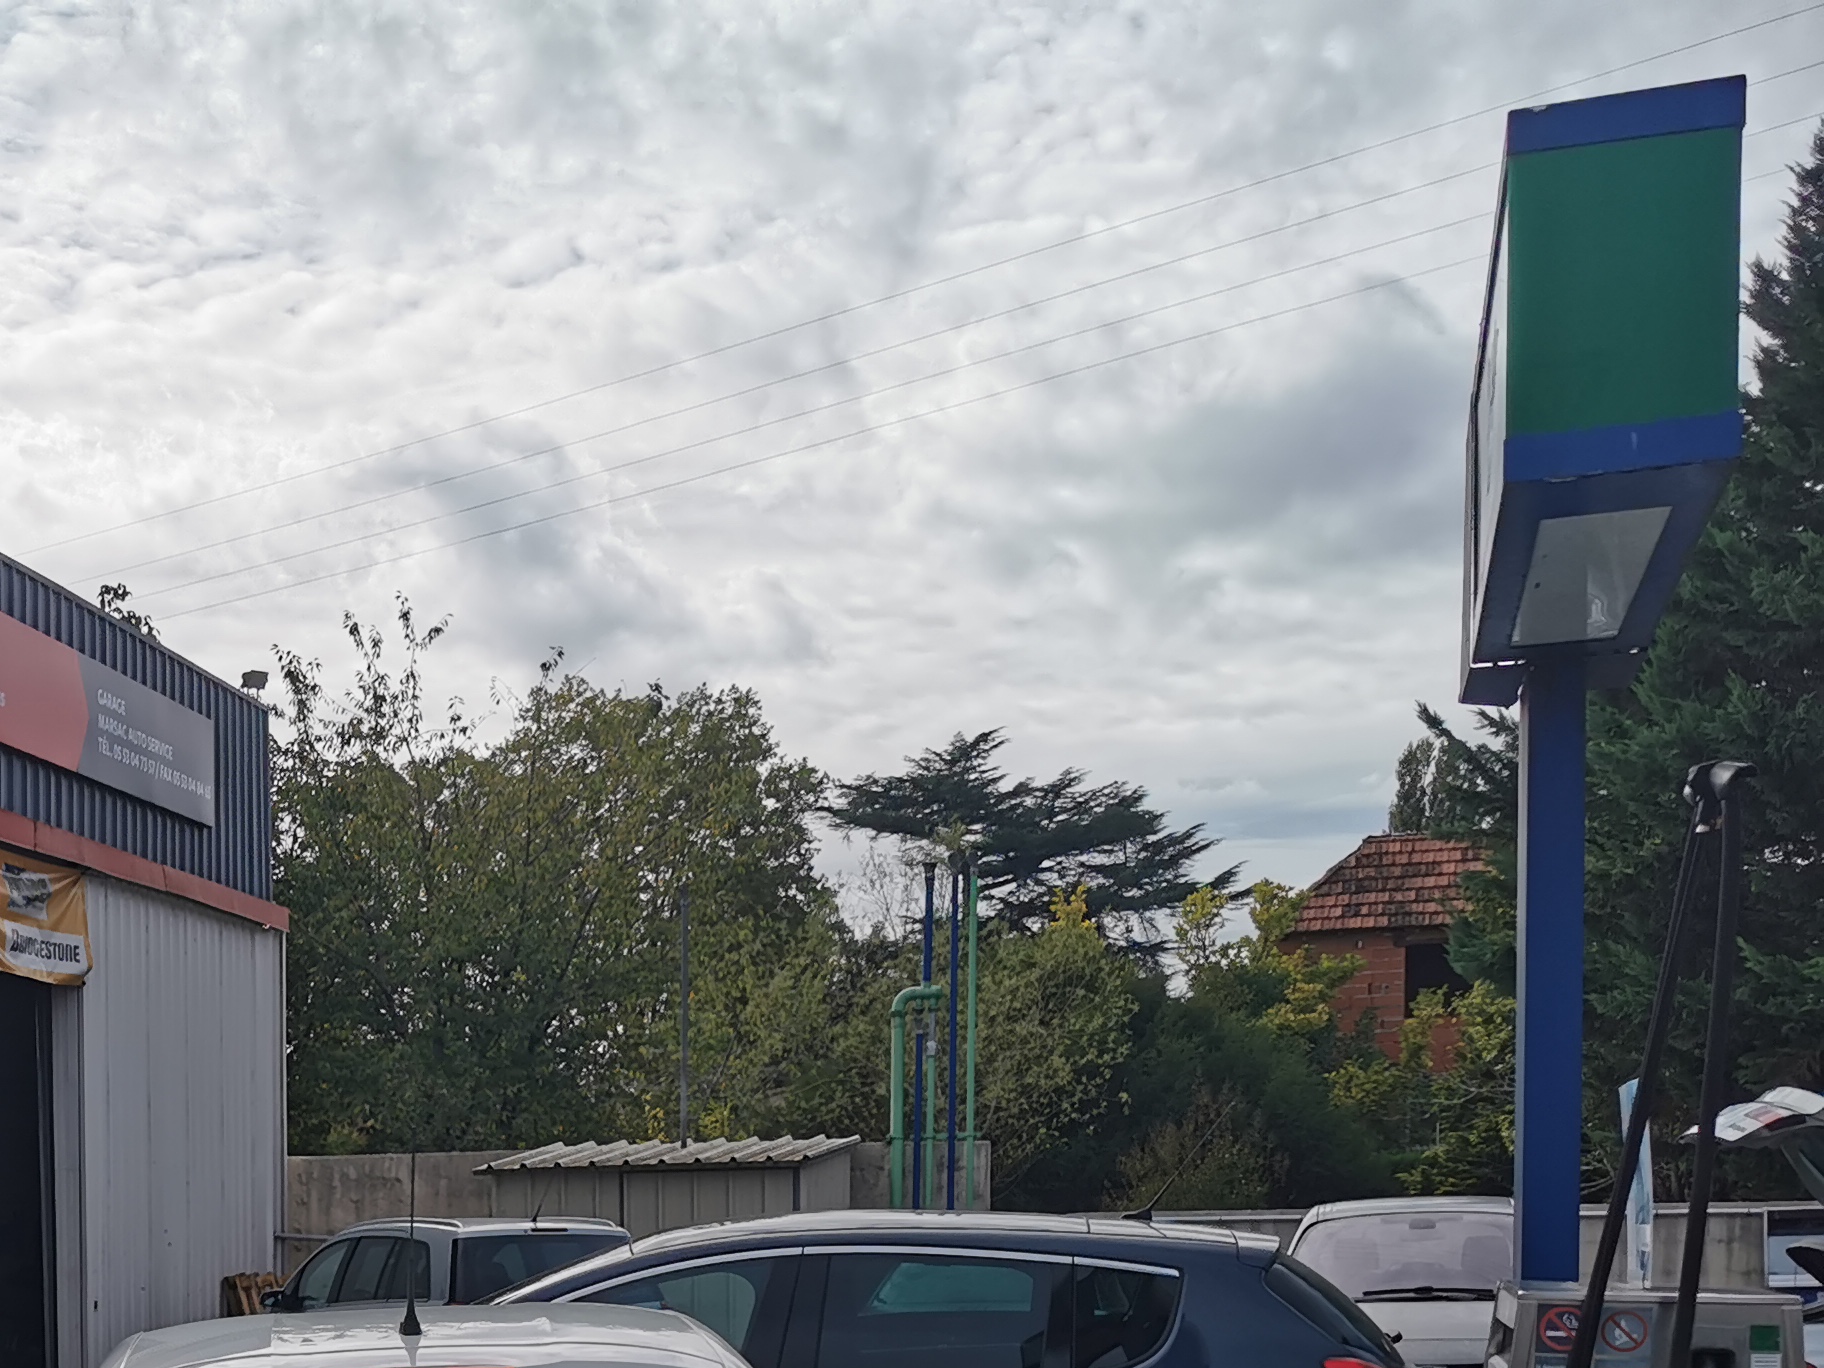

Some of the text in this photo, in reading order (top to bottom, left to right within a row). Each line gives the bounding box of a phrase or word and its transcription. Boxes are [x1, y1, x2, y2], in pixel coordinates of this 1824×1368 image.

[97, 688, 126, 716] GARAGE
[98, 713, 174, 761] MARSAC AUTO SERVICE
